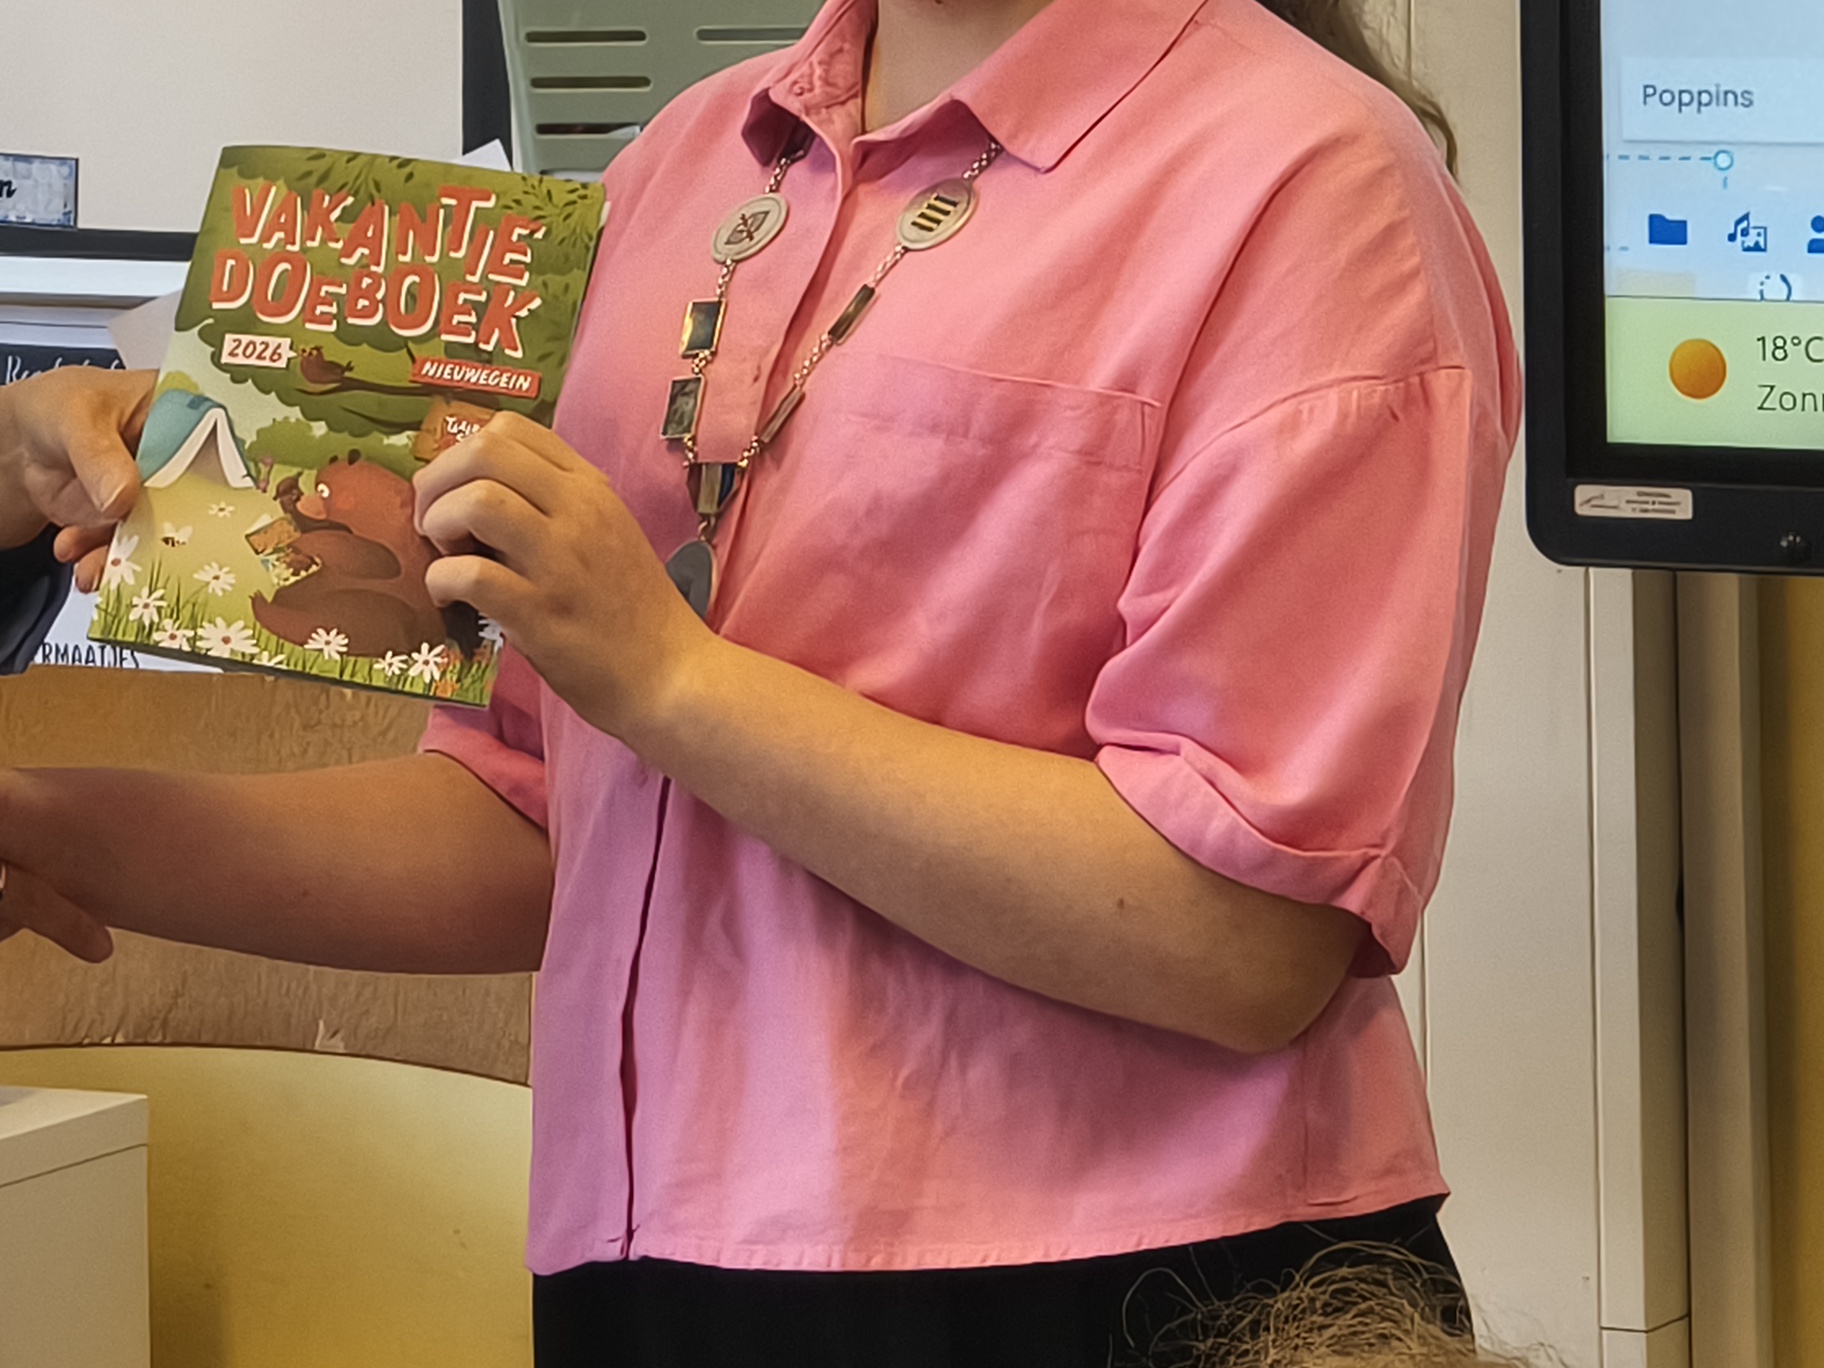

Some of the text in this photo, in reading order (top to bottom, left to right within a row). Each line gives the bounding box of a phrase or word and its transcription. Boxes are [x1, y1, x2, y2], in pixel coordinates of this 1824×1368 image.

[1642, 84, 1755, 113] Poppins
[232, 181, 547, 287] VAKANTIE
[209, 248, 543, 359] DOEBOEK
[226, 338, 284, 364] 2026
[421, 360, 532, 393] NIEUWEGEIN
[1757, 385, 1824, 412] Zon
